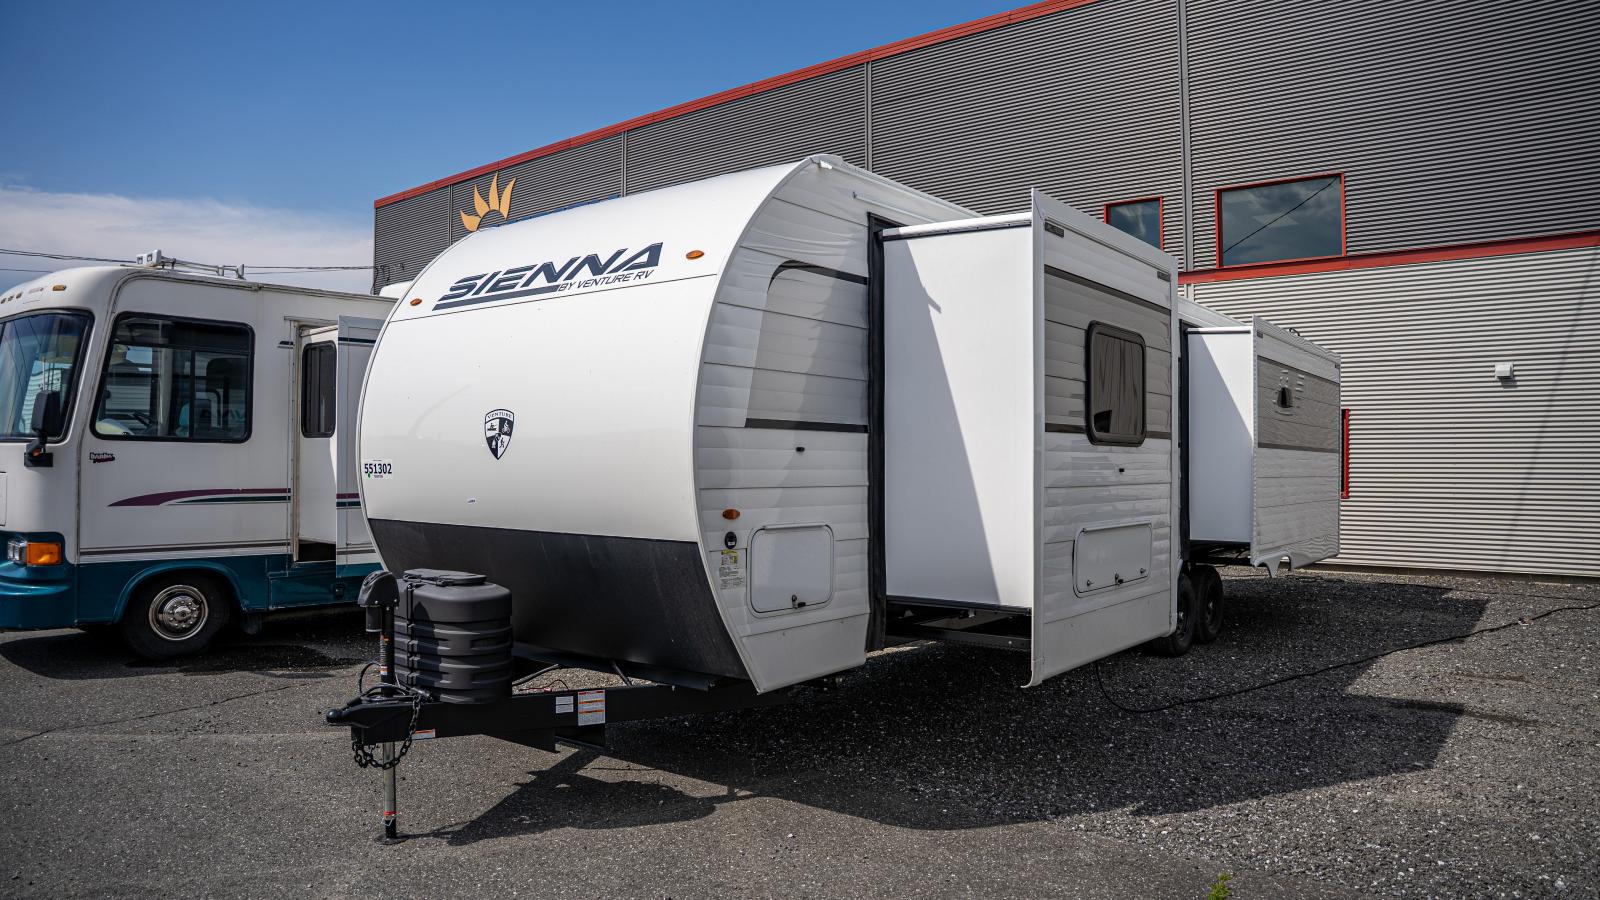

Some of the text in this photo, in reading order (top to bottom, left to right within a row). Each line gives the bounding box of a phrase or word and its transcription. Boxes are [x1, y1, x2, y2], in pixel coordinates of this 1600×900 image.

[438, 242, 663, 302] SIENNA
[558, 269, 655, 292] BY VENTURE RV
[487, 411, 512, 419] VENTURE
[364, 463, 392, 474] 551302
